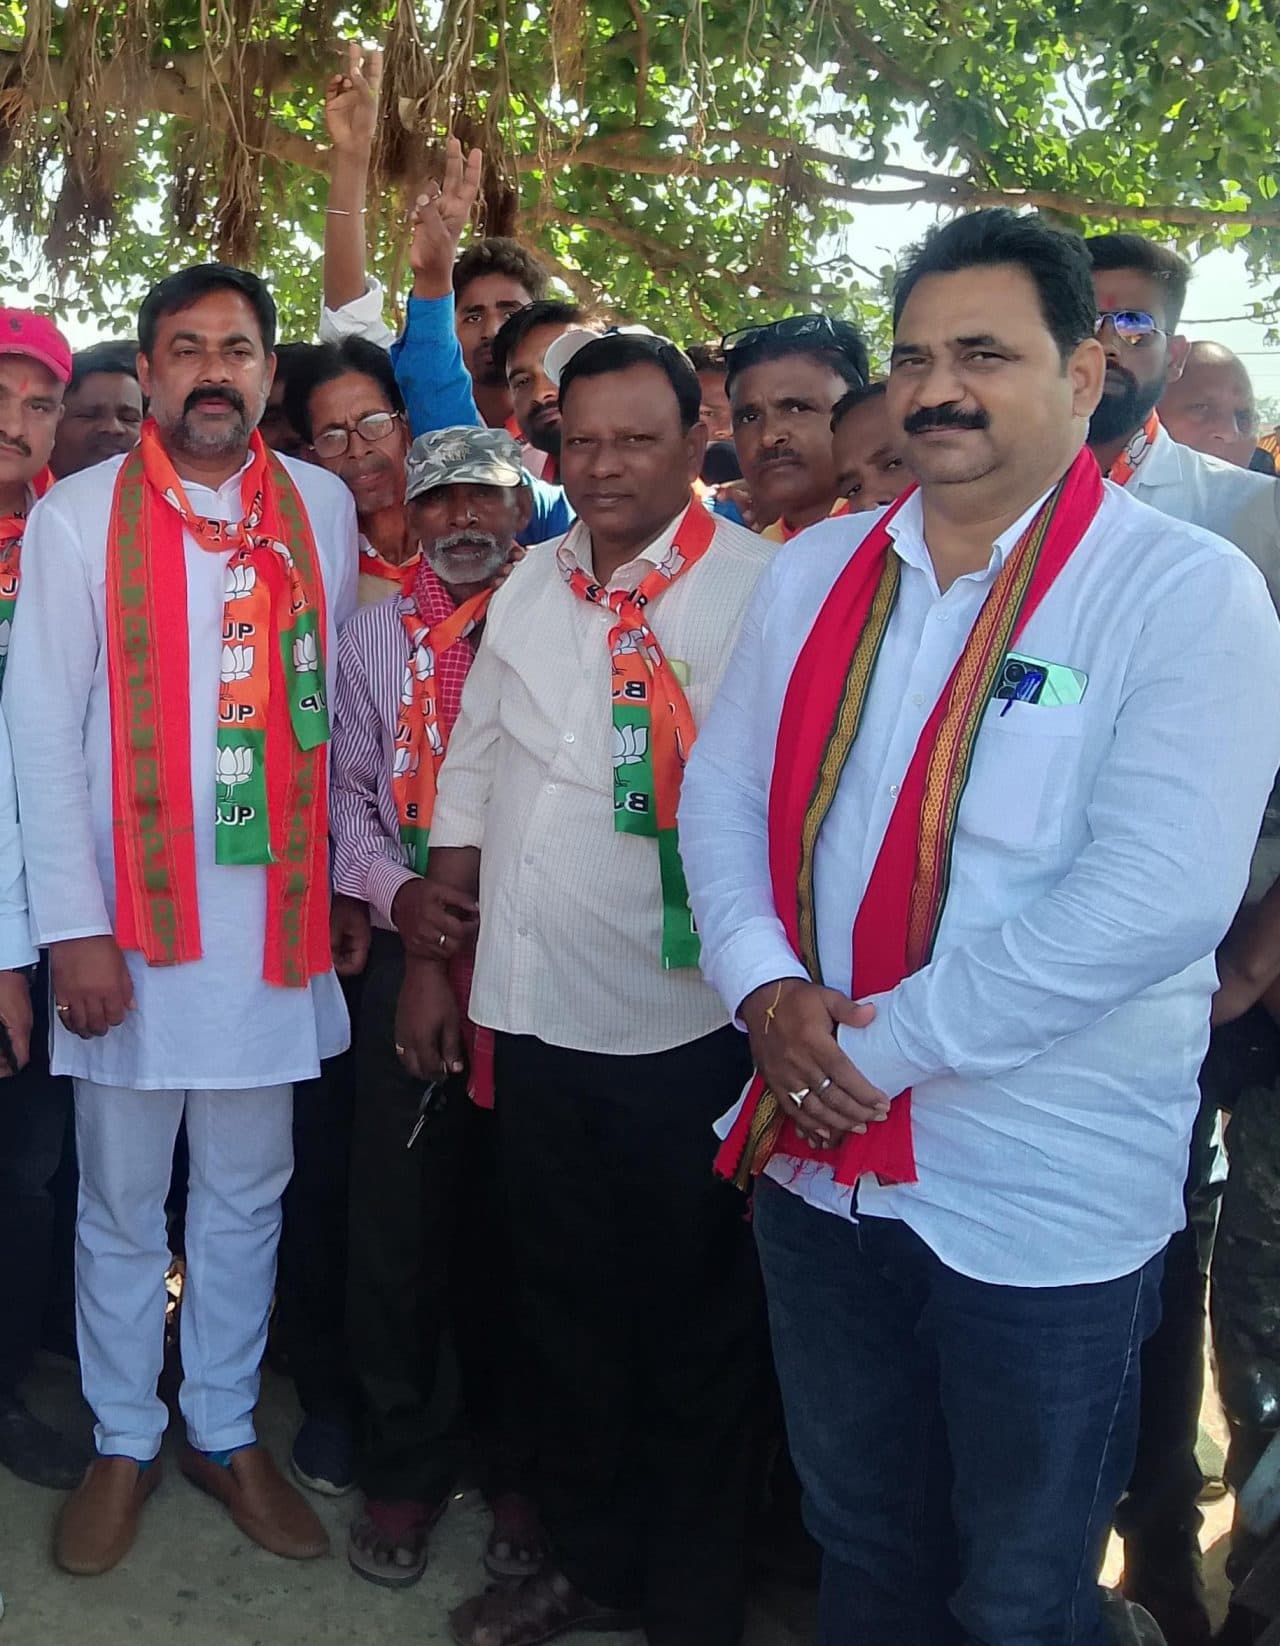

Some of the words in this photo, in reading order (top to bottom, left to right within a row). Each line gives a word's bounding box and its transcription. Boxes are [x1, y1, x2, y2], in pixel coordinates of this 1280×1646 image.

[222, 621, 256, 641] JP
[219, 703, 256, 723] JP
[215, 805, 255, 826] JP
